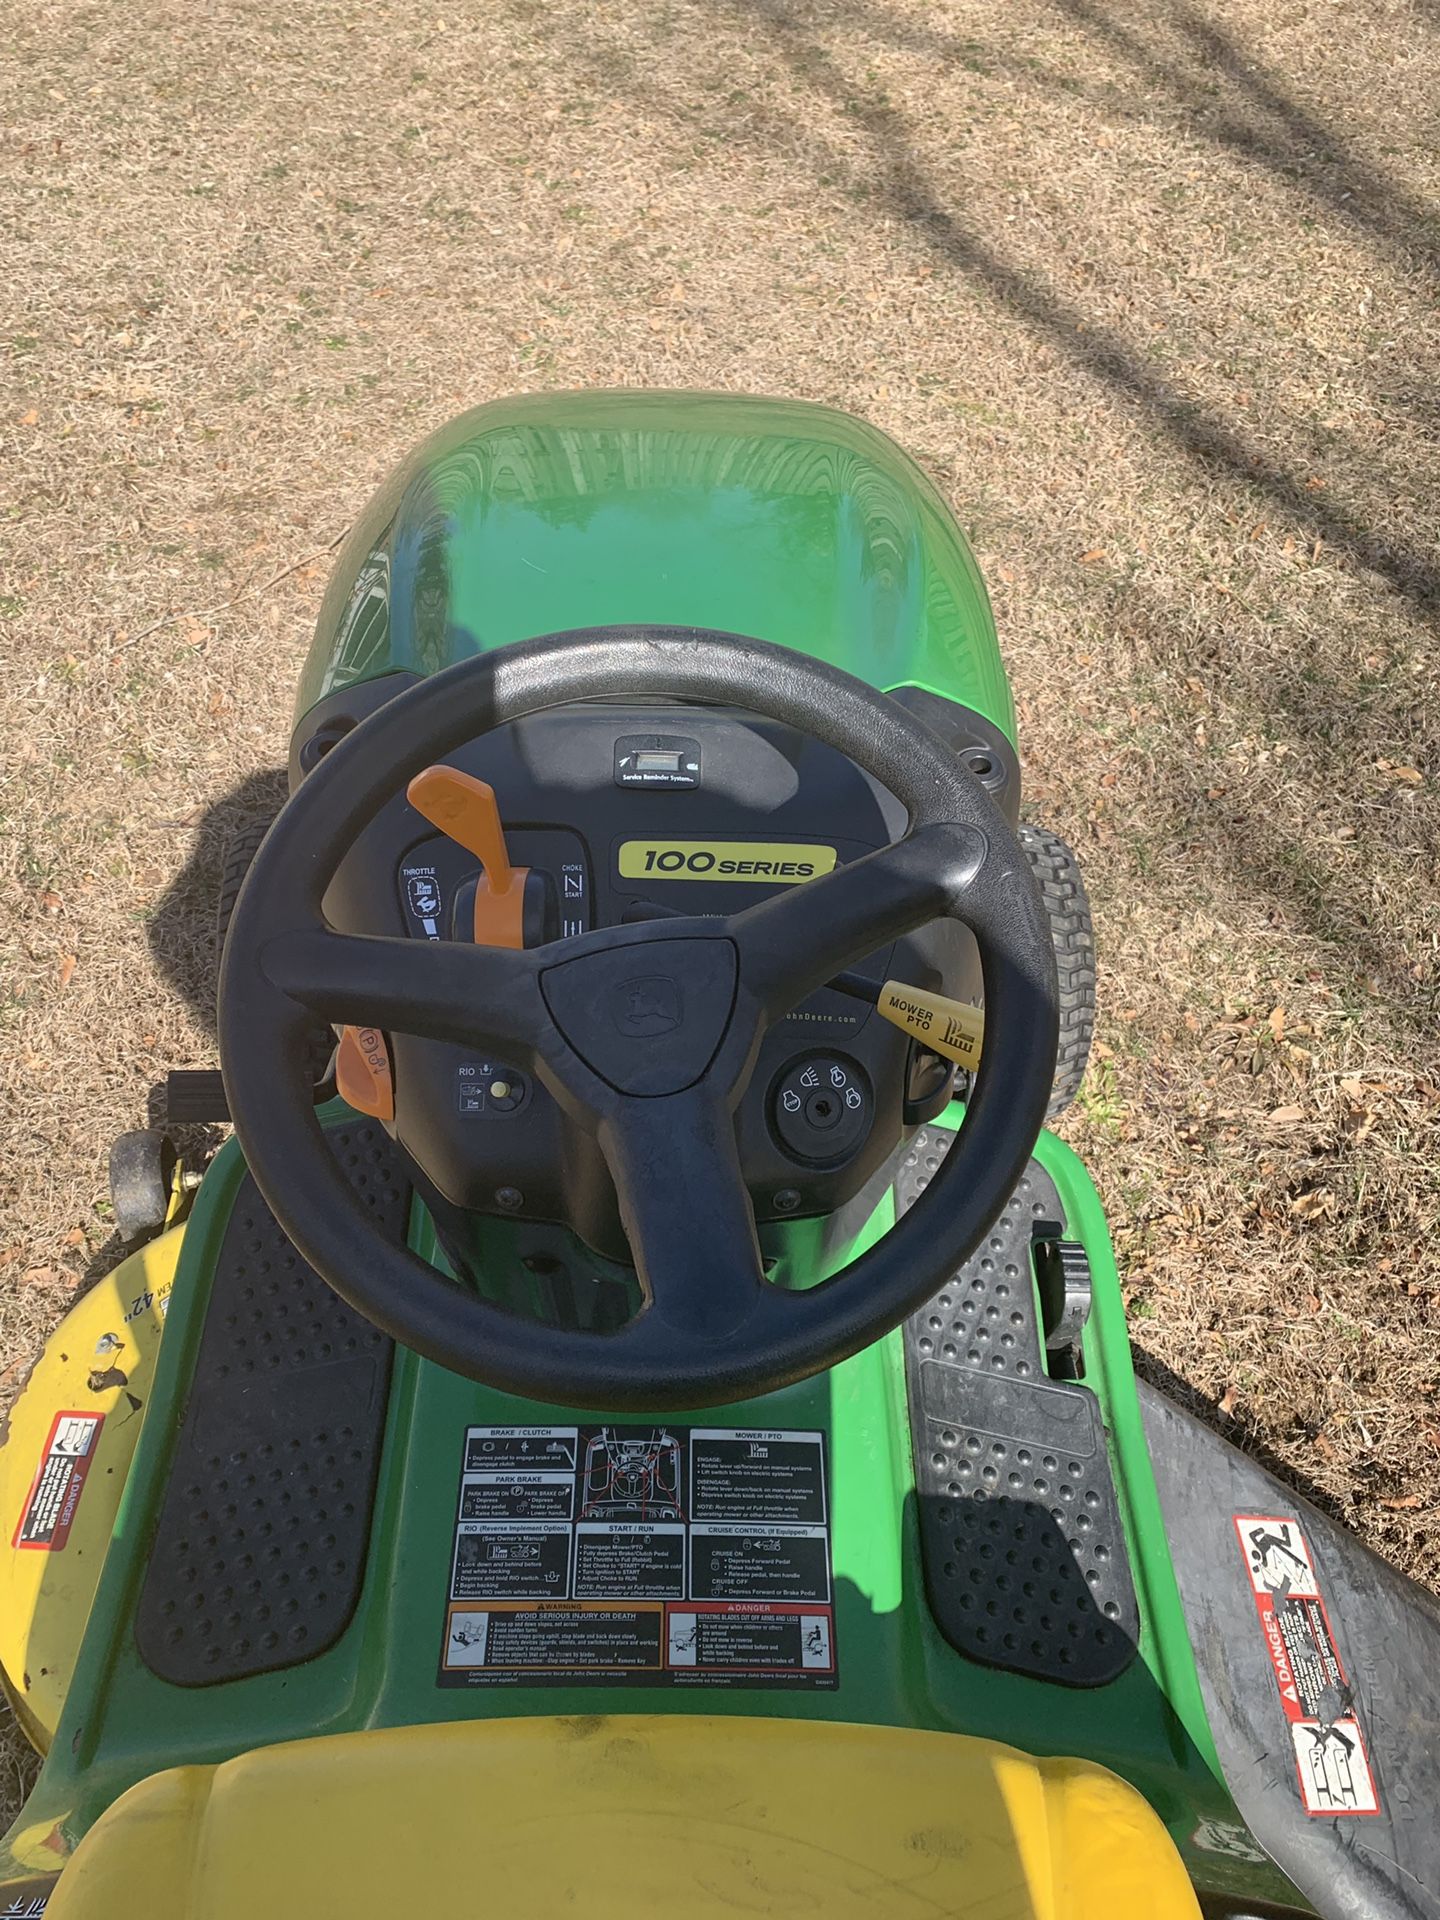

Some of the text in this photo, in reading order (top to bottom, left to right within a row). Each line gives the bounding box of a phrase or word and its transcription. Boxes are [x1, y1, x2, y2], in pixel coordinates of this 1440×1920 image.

[645, 851, 814, 876] 100 SERIES
[786, 1012, 856, 1023] ohnDeere.com
[889, 997, 933, 1021] MOWER
[907, 1016, 930, 1030] PTO
[459, 1068, 475, 1076] RIO
[46, 1464, 74, 1530] ROTATING BLADE
[60, 1485, 80, 1526] DANGER
[1263, 1610, 1291, 1682] DANGER
[1278, 1617, 1304, 1697] ROTATING BLADE
